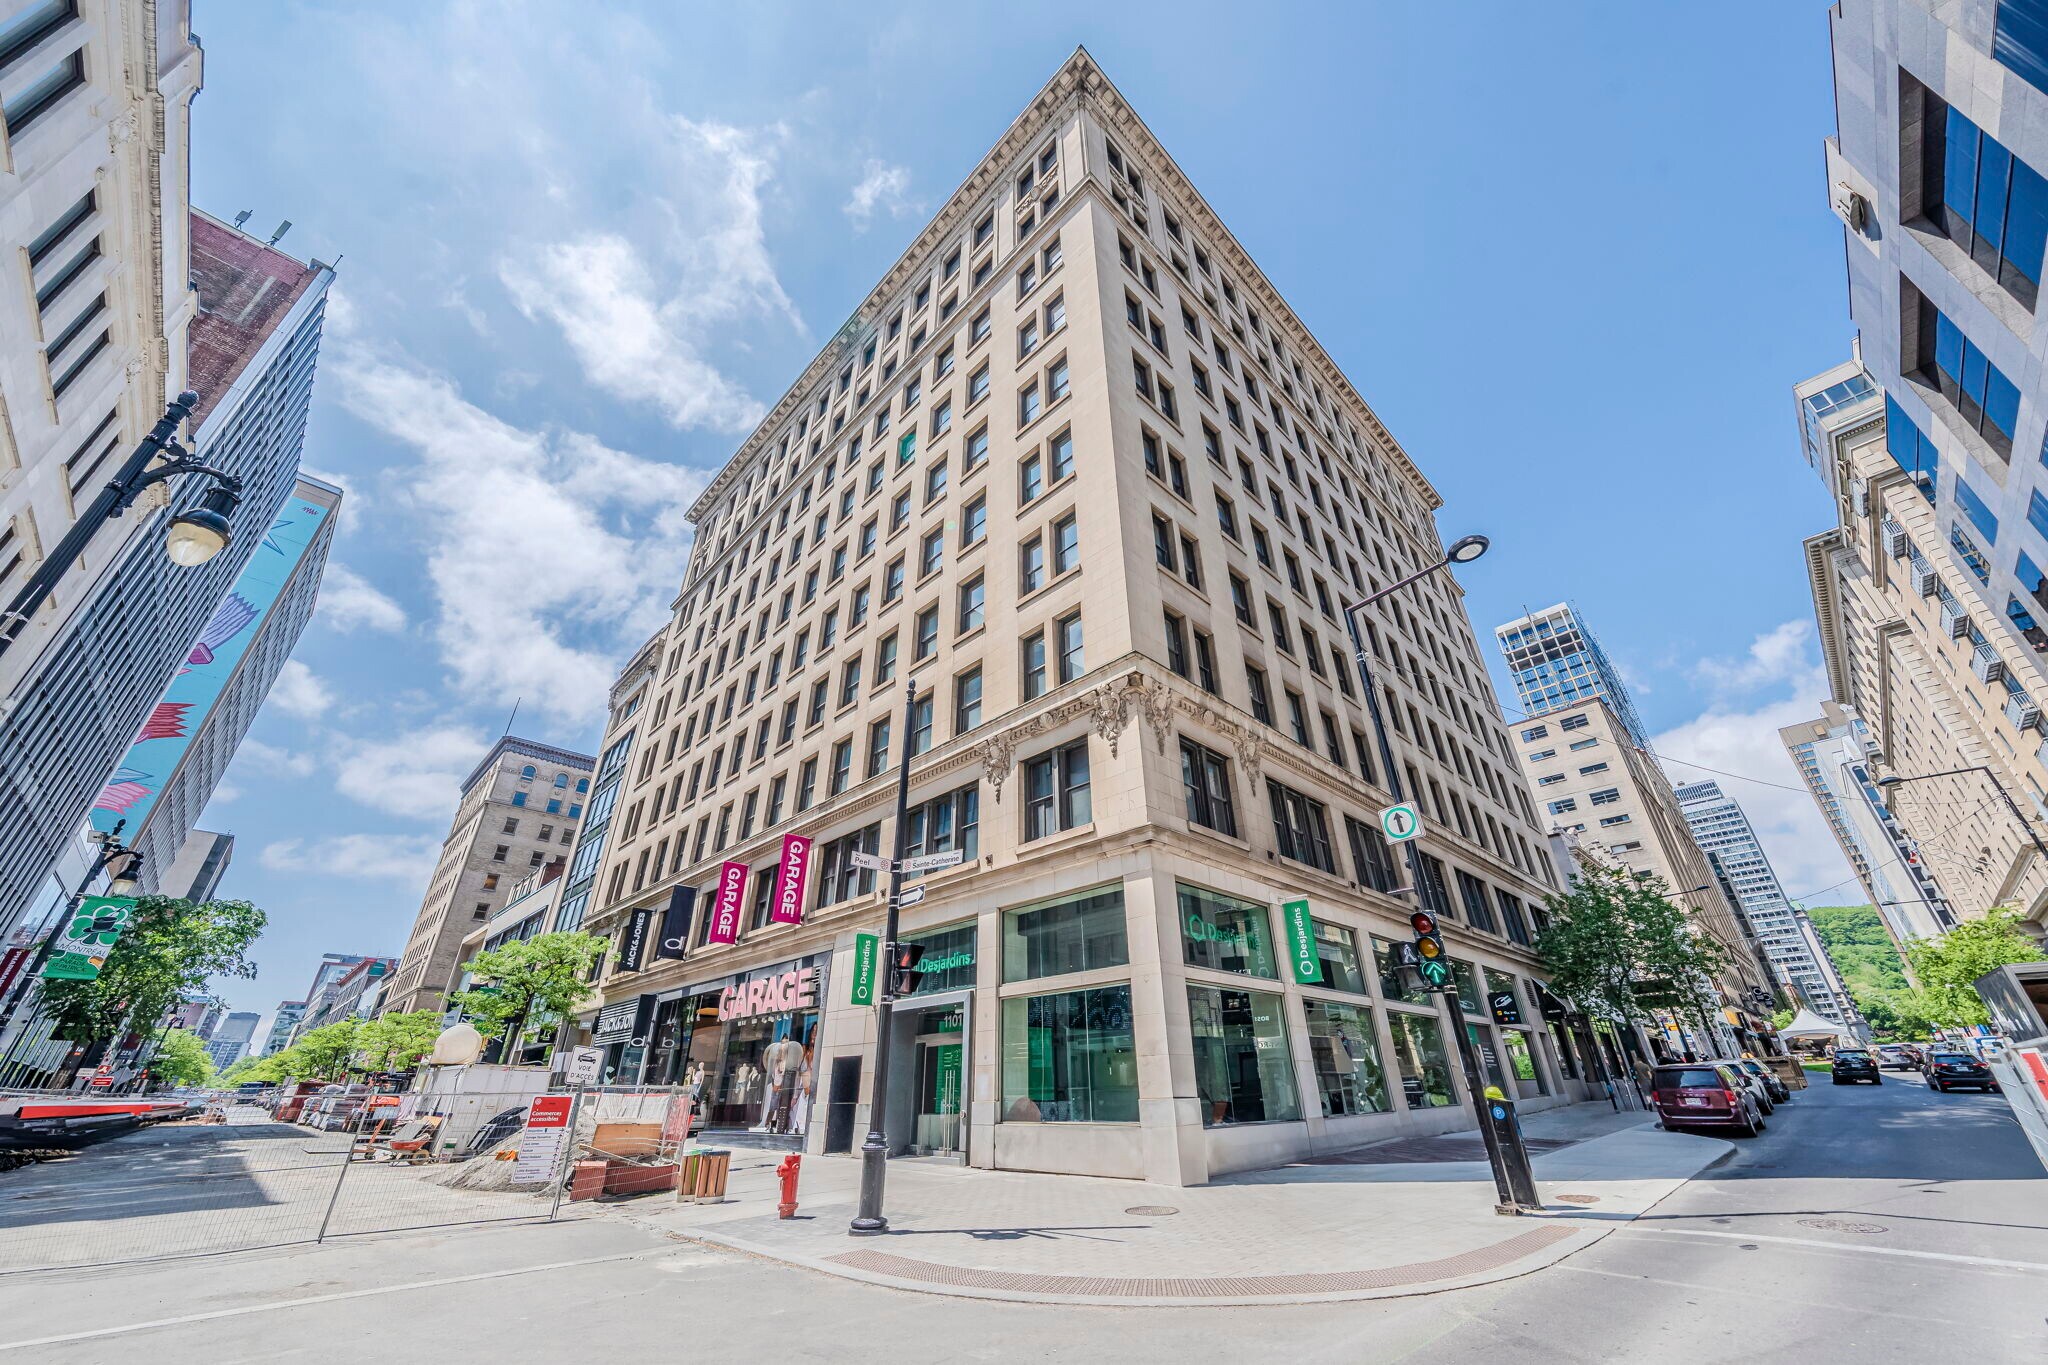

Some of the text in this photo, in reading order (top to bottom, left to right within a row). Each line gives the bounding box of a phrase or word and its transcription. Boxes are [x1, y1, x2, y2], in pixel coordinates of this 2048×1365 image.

[781, 841, 804, 918] GARAGE
[854, 856, 870, 866] Peel
[912, 855, 960, 869] Sainte-Catherine
[717, 868, 741, 938] GARAGE
[59, 943, 107, 957] MONTRÉAL
[627, 912, 646, 968] JACK&JONES
[1294, 907, 1309, 958] Desjardins
[859, 940, 871, 984] Desjardins
[920, 951, 973, 974] Desjardins
[719, 967, 815, 1021] GARAGE
[943, 1014, 963, 1028] 1101
